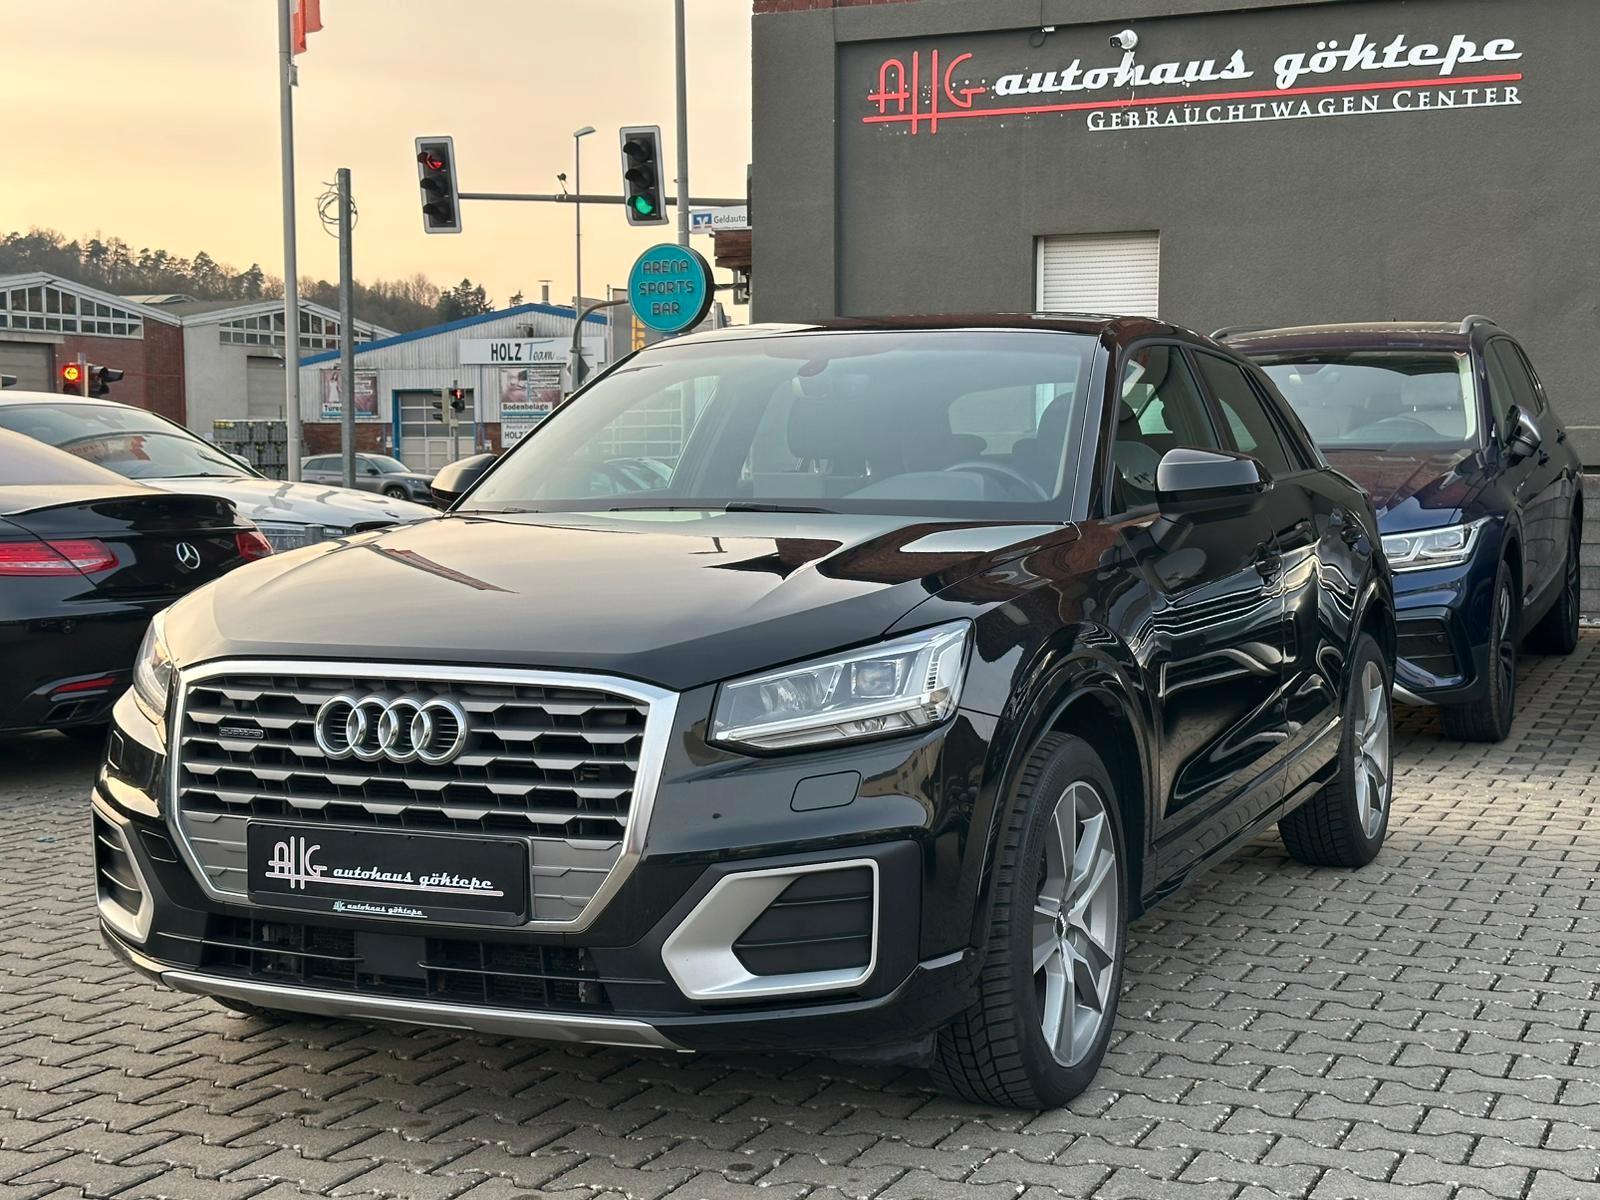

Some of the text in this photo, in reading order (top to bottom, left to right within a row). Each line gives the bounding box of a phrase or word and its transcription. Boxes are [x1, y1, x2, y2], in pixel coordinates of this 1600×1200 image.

[995, 48, 1255, 96] autohaus
[1273, 33, 1523, 90] göktepe
[1392, 86, 1521, 110] CENTER
[642, 259, 689, 274] ARENA
[638, 280, 695, 296] SPORTS
[652, 302, 681, 316] BAR
[491, 340, 556, 362] HOLZ Team
[333, 865, 414, 884] autohaus
[418, 871, 494, 889] göktepe
[347, 903, 386, 913] autohaus
